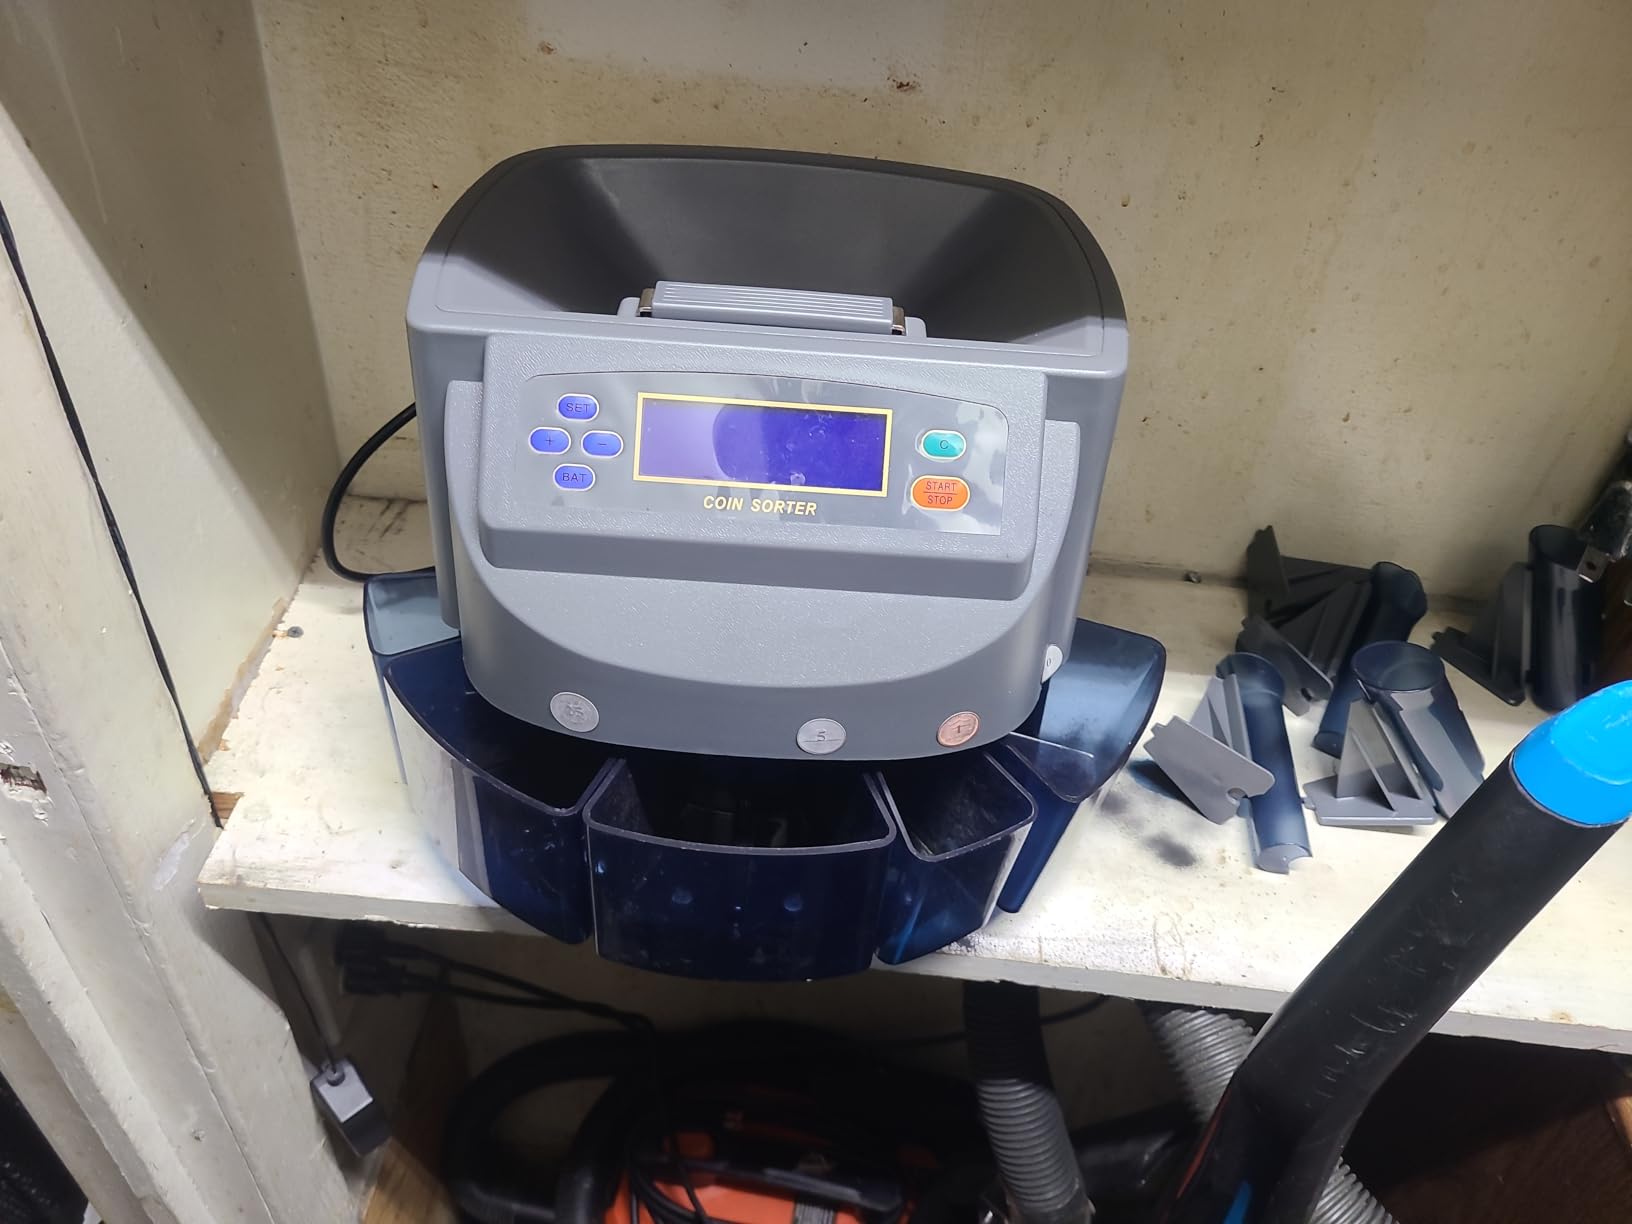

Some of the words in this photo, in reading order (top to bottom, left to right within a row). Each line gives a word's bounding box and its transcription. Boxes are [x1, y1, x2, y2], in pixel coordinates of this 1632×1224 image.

[565, 402, 591, 413] SET
[939, 439, 950, 450] C
[562, 472, 587, 483] BAT
[925, 480, 958, 492] START
[927, 494, 953, 505] STOP
[703, 495, 744, 511] COIN
[750, 498, 817, 516] SORTER
[816, 729, 826, 742] 5
